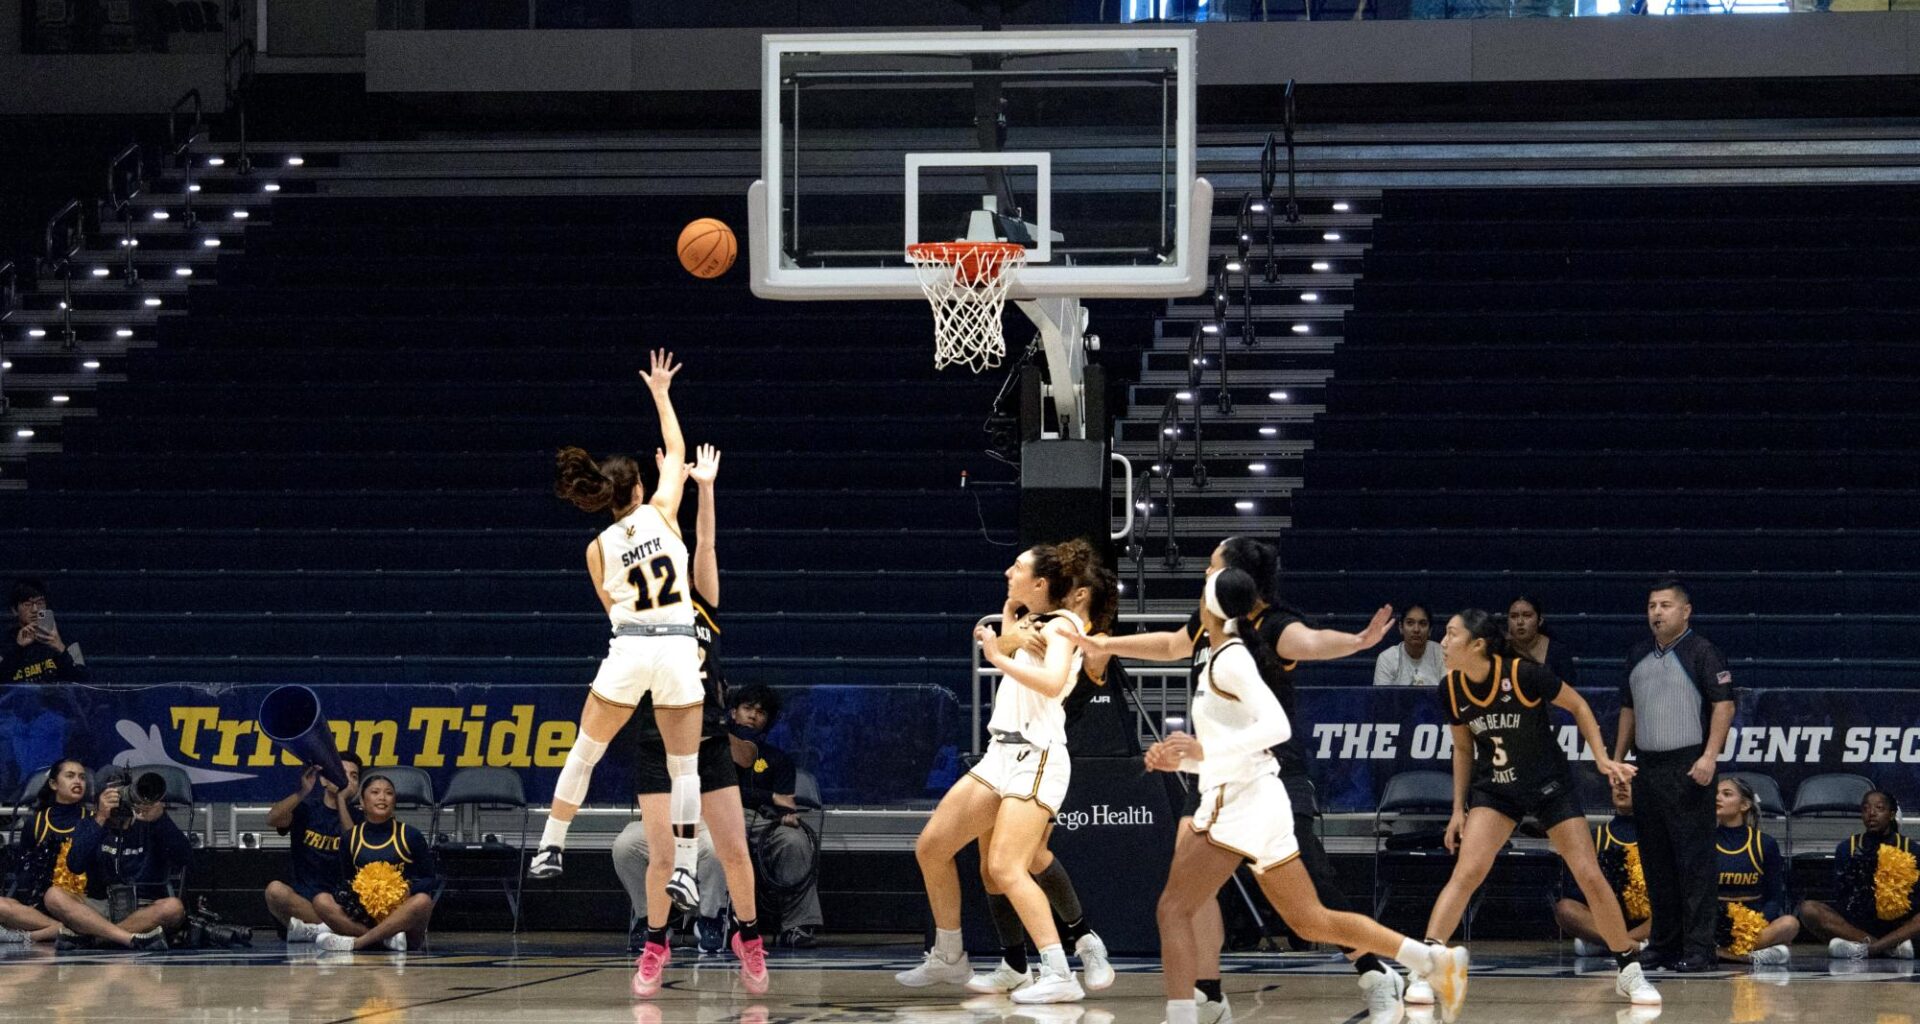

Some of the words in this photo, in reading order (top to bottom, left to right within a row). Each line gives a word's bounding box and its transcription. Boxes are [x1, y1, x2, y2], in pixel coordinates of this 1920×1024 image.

[621, 537, 663, 567] SMITH
[626, 554, 683, 612] 12
[696, 625, 711, 643] ACH
[1090, 695, 1111, 704] UR
[169, 706, 399, 766] Trin
[408, 704, 578, 767] Tide
[1468, 716, 1488, 735] ONG
[1486, 713, 1521, 730] BEACH
[1312, 723, 1401, 760] THE
[1490, 736, 1508, 766] 5
[1053, 810, 1090, 831] ego
[1091, 804, 1154, 825] Health
[303, 829, 341, 850] TRITO
[1718, 871, 1759, 885] ITONS
